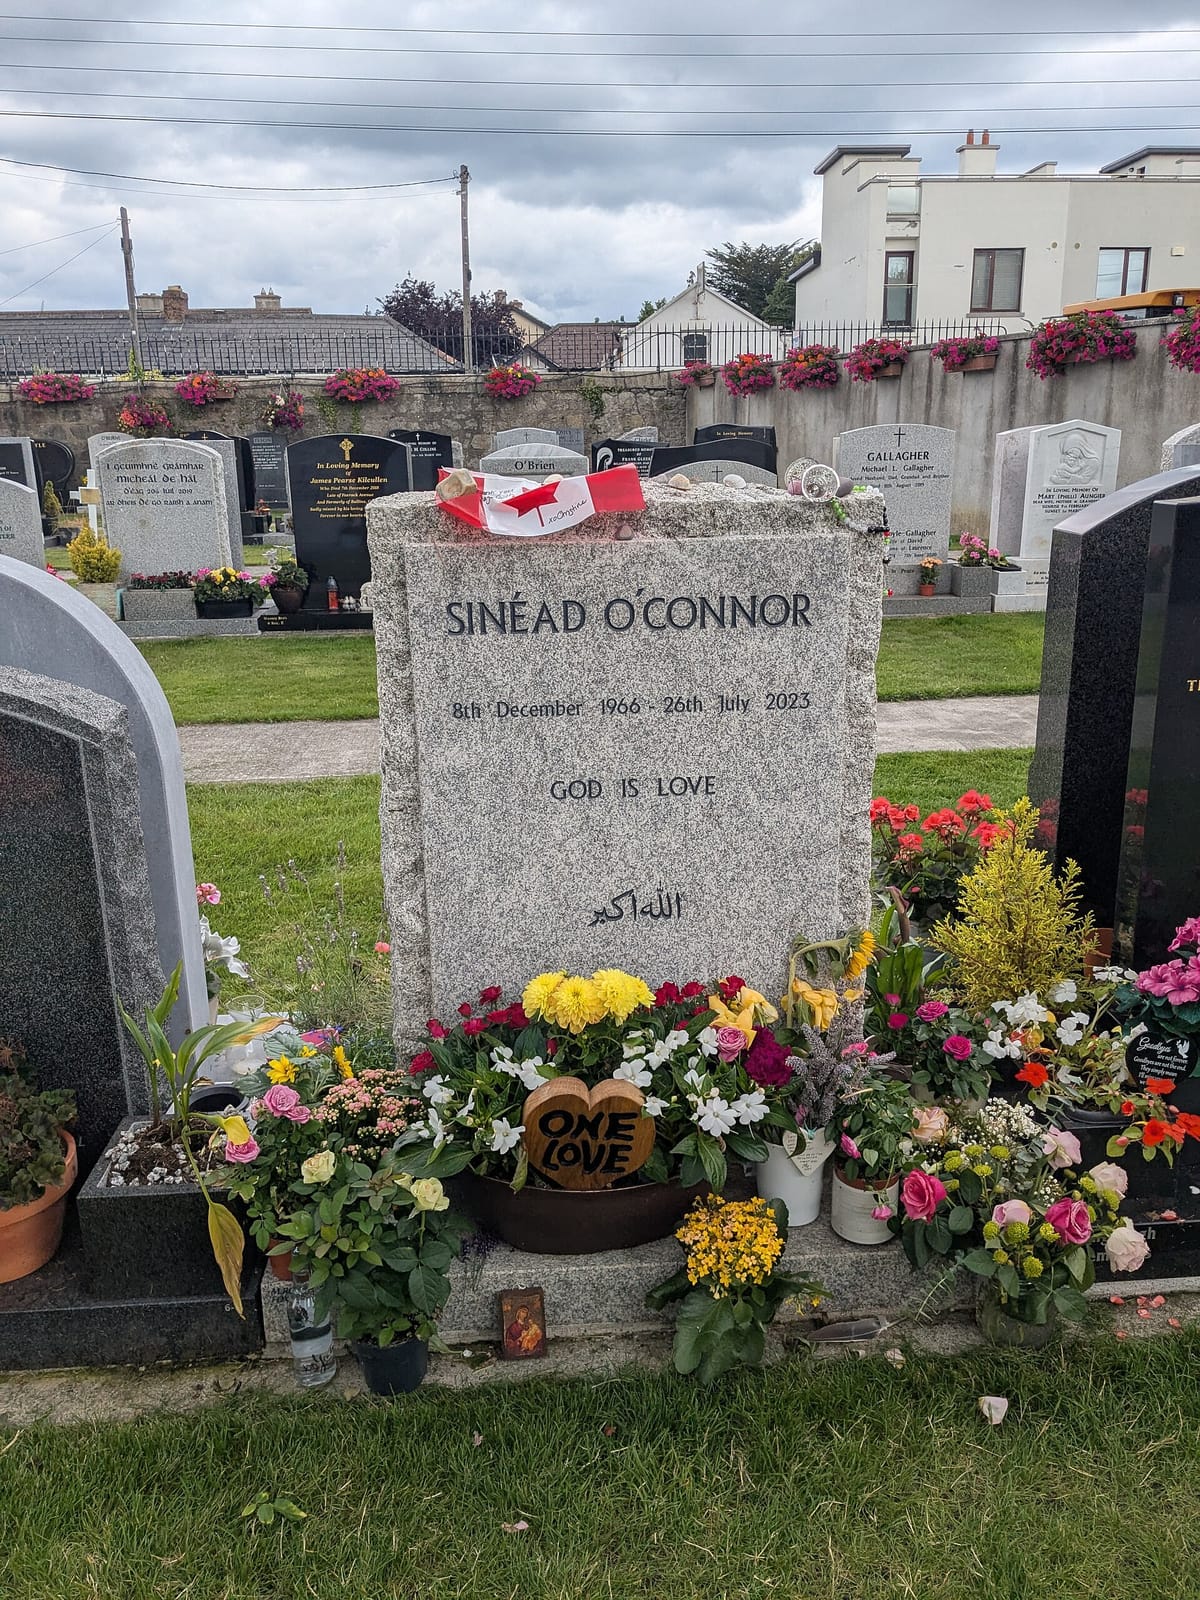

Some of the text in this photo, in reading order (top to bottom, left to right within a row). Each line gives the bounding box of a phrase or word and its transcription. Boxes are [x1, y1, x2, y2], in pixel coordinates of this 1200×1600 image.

[514, 460, 555, 470] O'Brien
[867, 451, 930, 461] GALLAGHER
[447, 588, 812, 636] SINÉAD O'CONNOR
[452, 702, 482, 719] 8th
[496, 701, 582, 718] December
[600, 698, 640, 714] 1966
[663, 696, 703, 713] 26th
[718, 694, 750, 715] July
[765, 693, 810, 710] 2023
[550, 776, 716, 800] GOD IS LOVE
[1136, 1037, 1172, 1054] Goodbyes
[538, 1110, 638, 1141] ONE
[542, 1139, 632, 1174] LOVE
